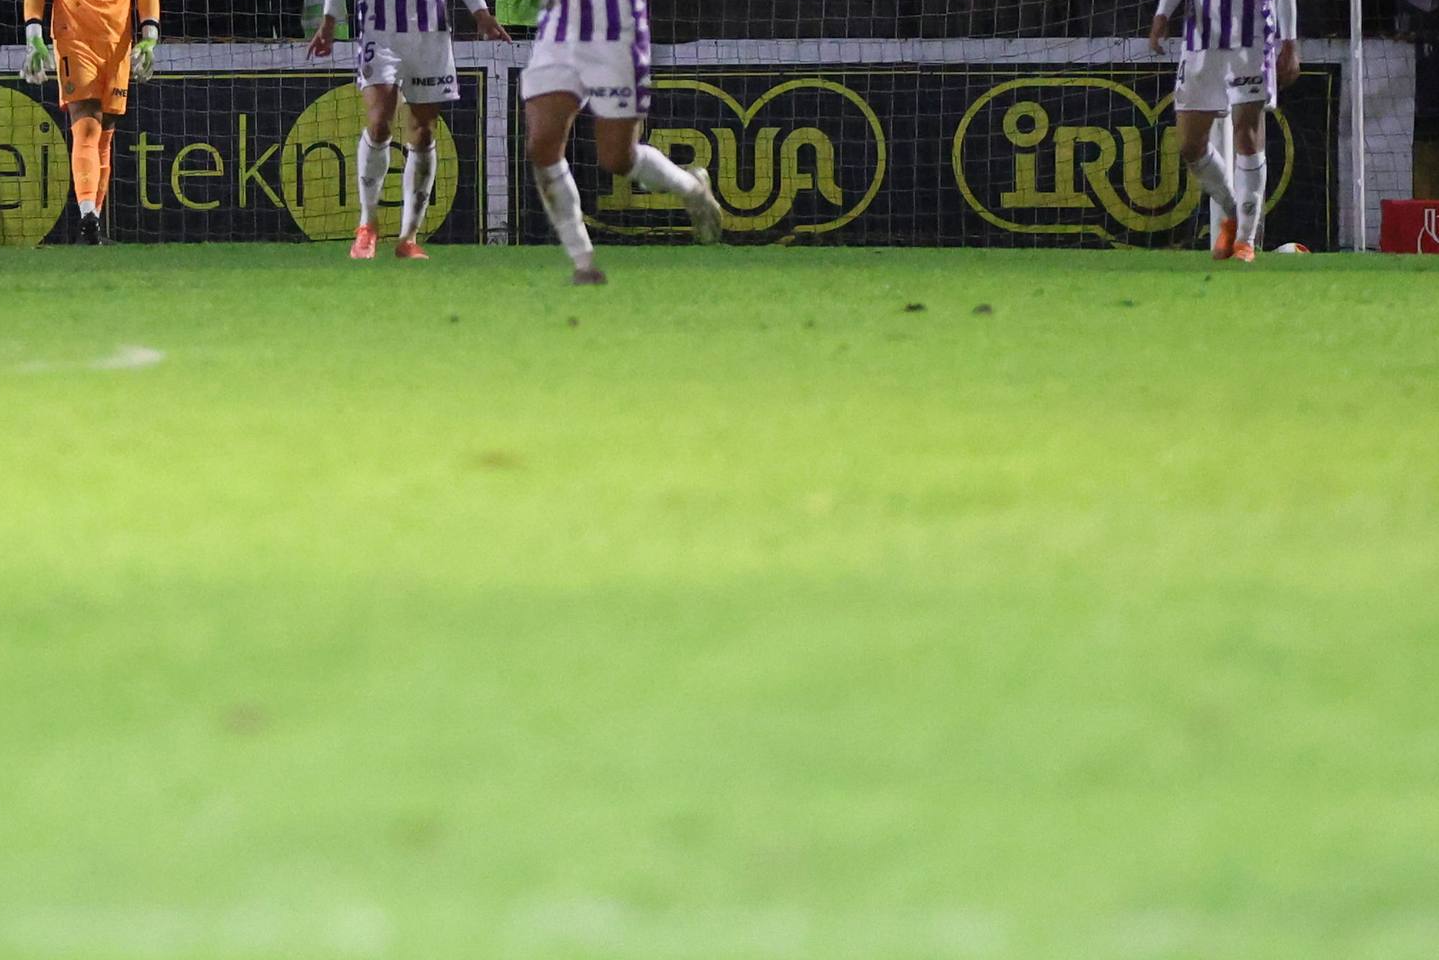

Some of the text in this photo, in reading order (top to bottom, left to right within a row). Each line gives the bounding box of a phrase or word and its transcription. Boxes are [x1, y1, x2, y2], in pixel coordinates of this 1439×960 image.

[62, 56, 70, 77] 1
[364, 41, 376, 62] 5
[411, 75, 454, 86] INEXO
[129, 113, 436, 210] tekne
[597, 126, 843, 232] RUA
[1000, 101, 1202, 232] iRU
